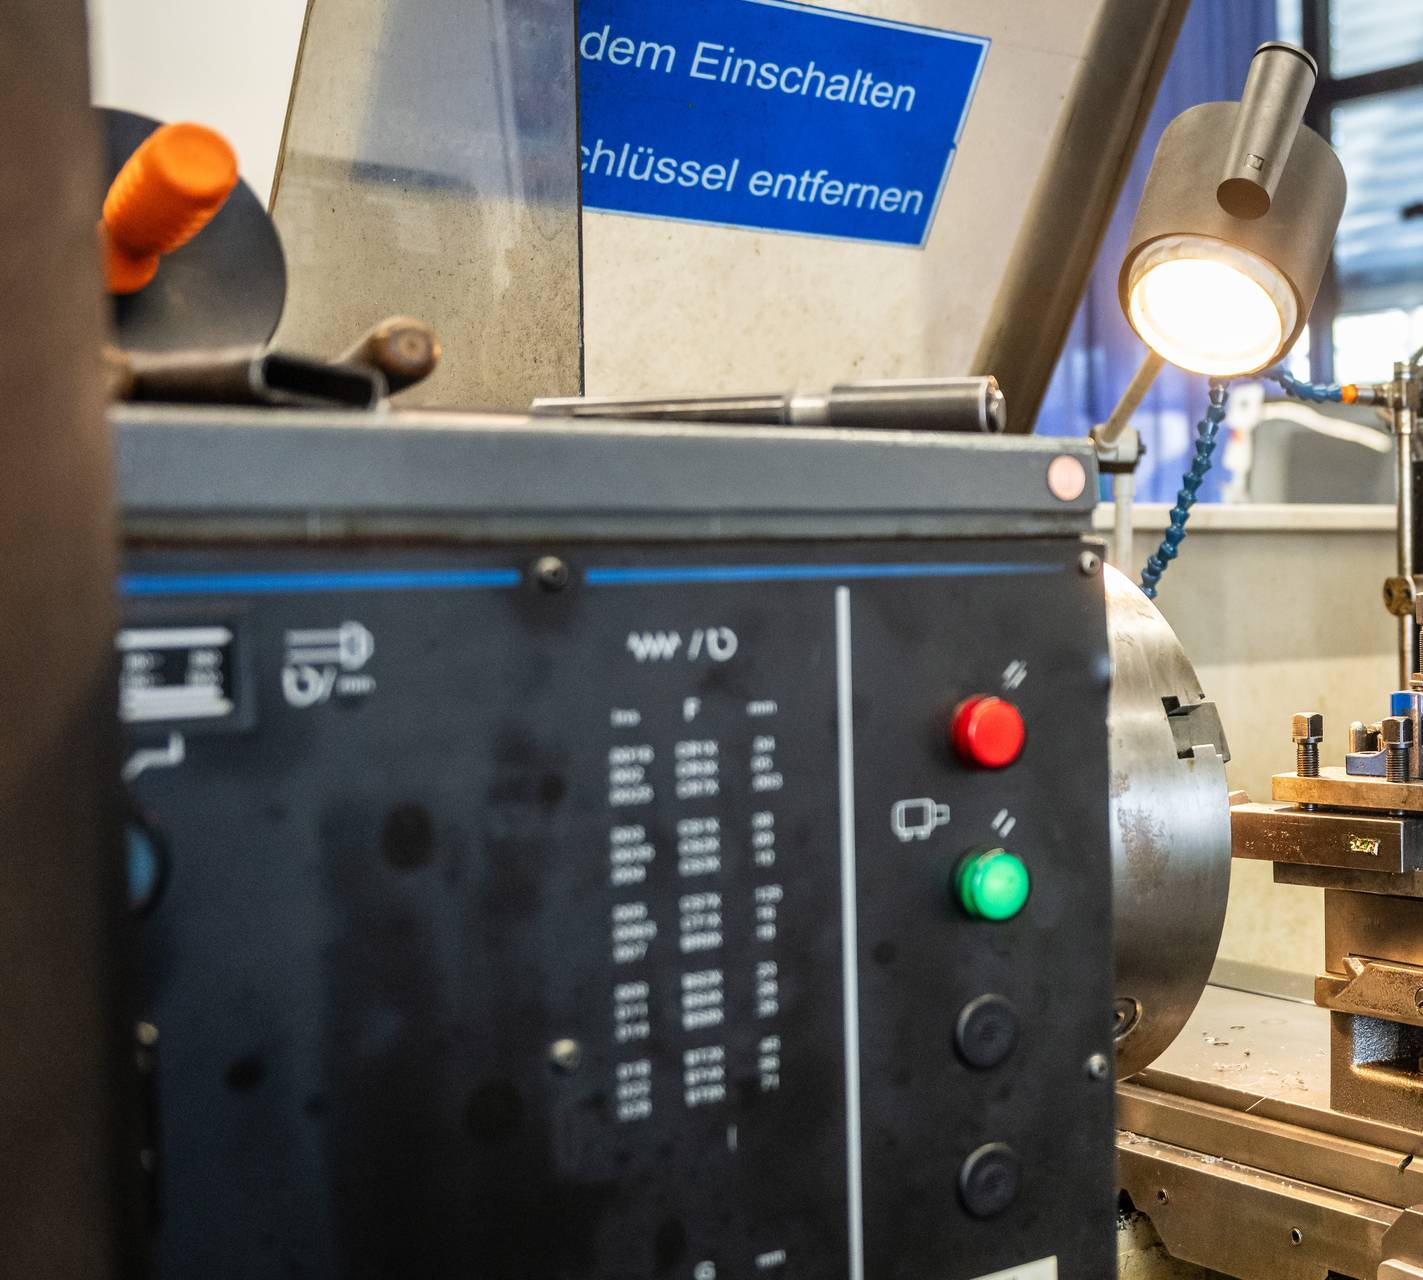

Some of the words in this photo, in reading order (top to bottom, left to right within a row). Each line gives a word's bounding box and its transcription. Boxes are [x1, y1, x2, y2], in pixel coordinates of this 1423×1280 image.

[579, 25, 677, 73] dem
[689, 40, 917, 112] Einschalten
[748, 170, 924, 215] entfernen
